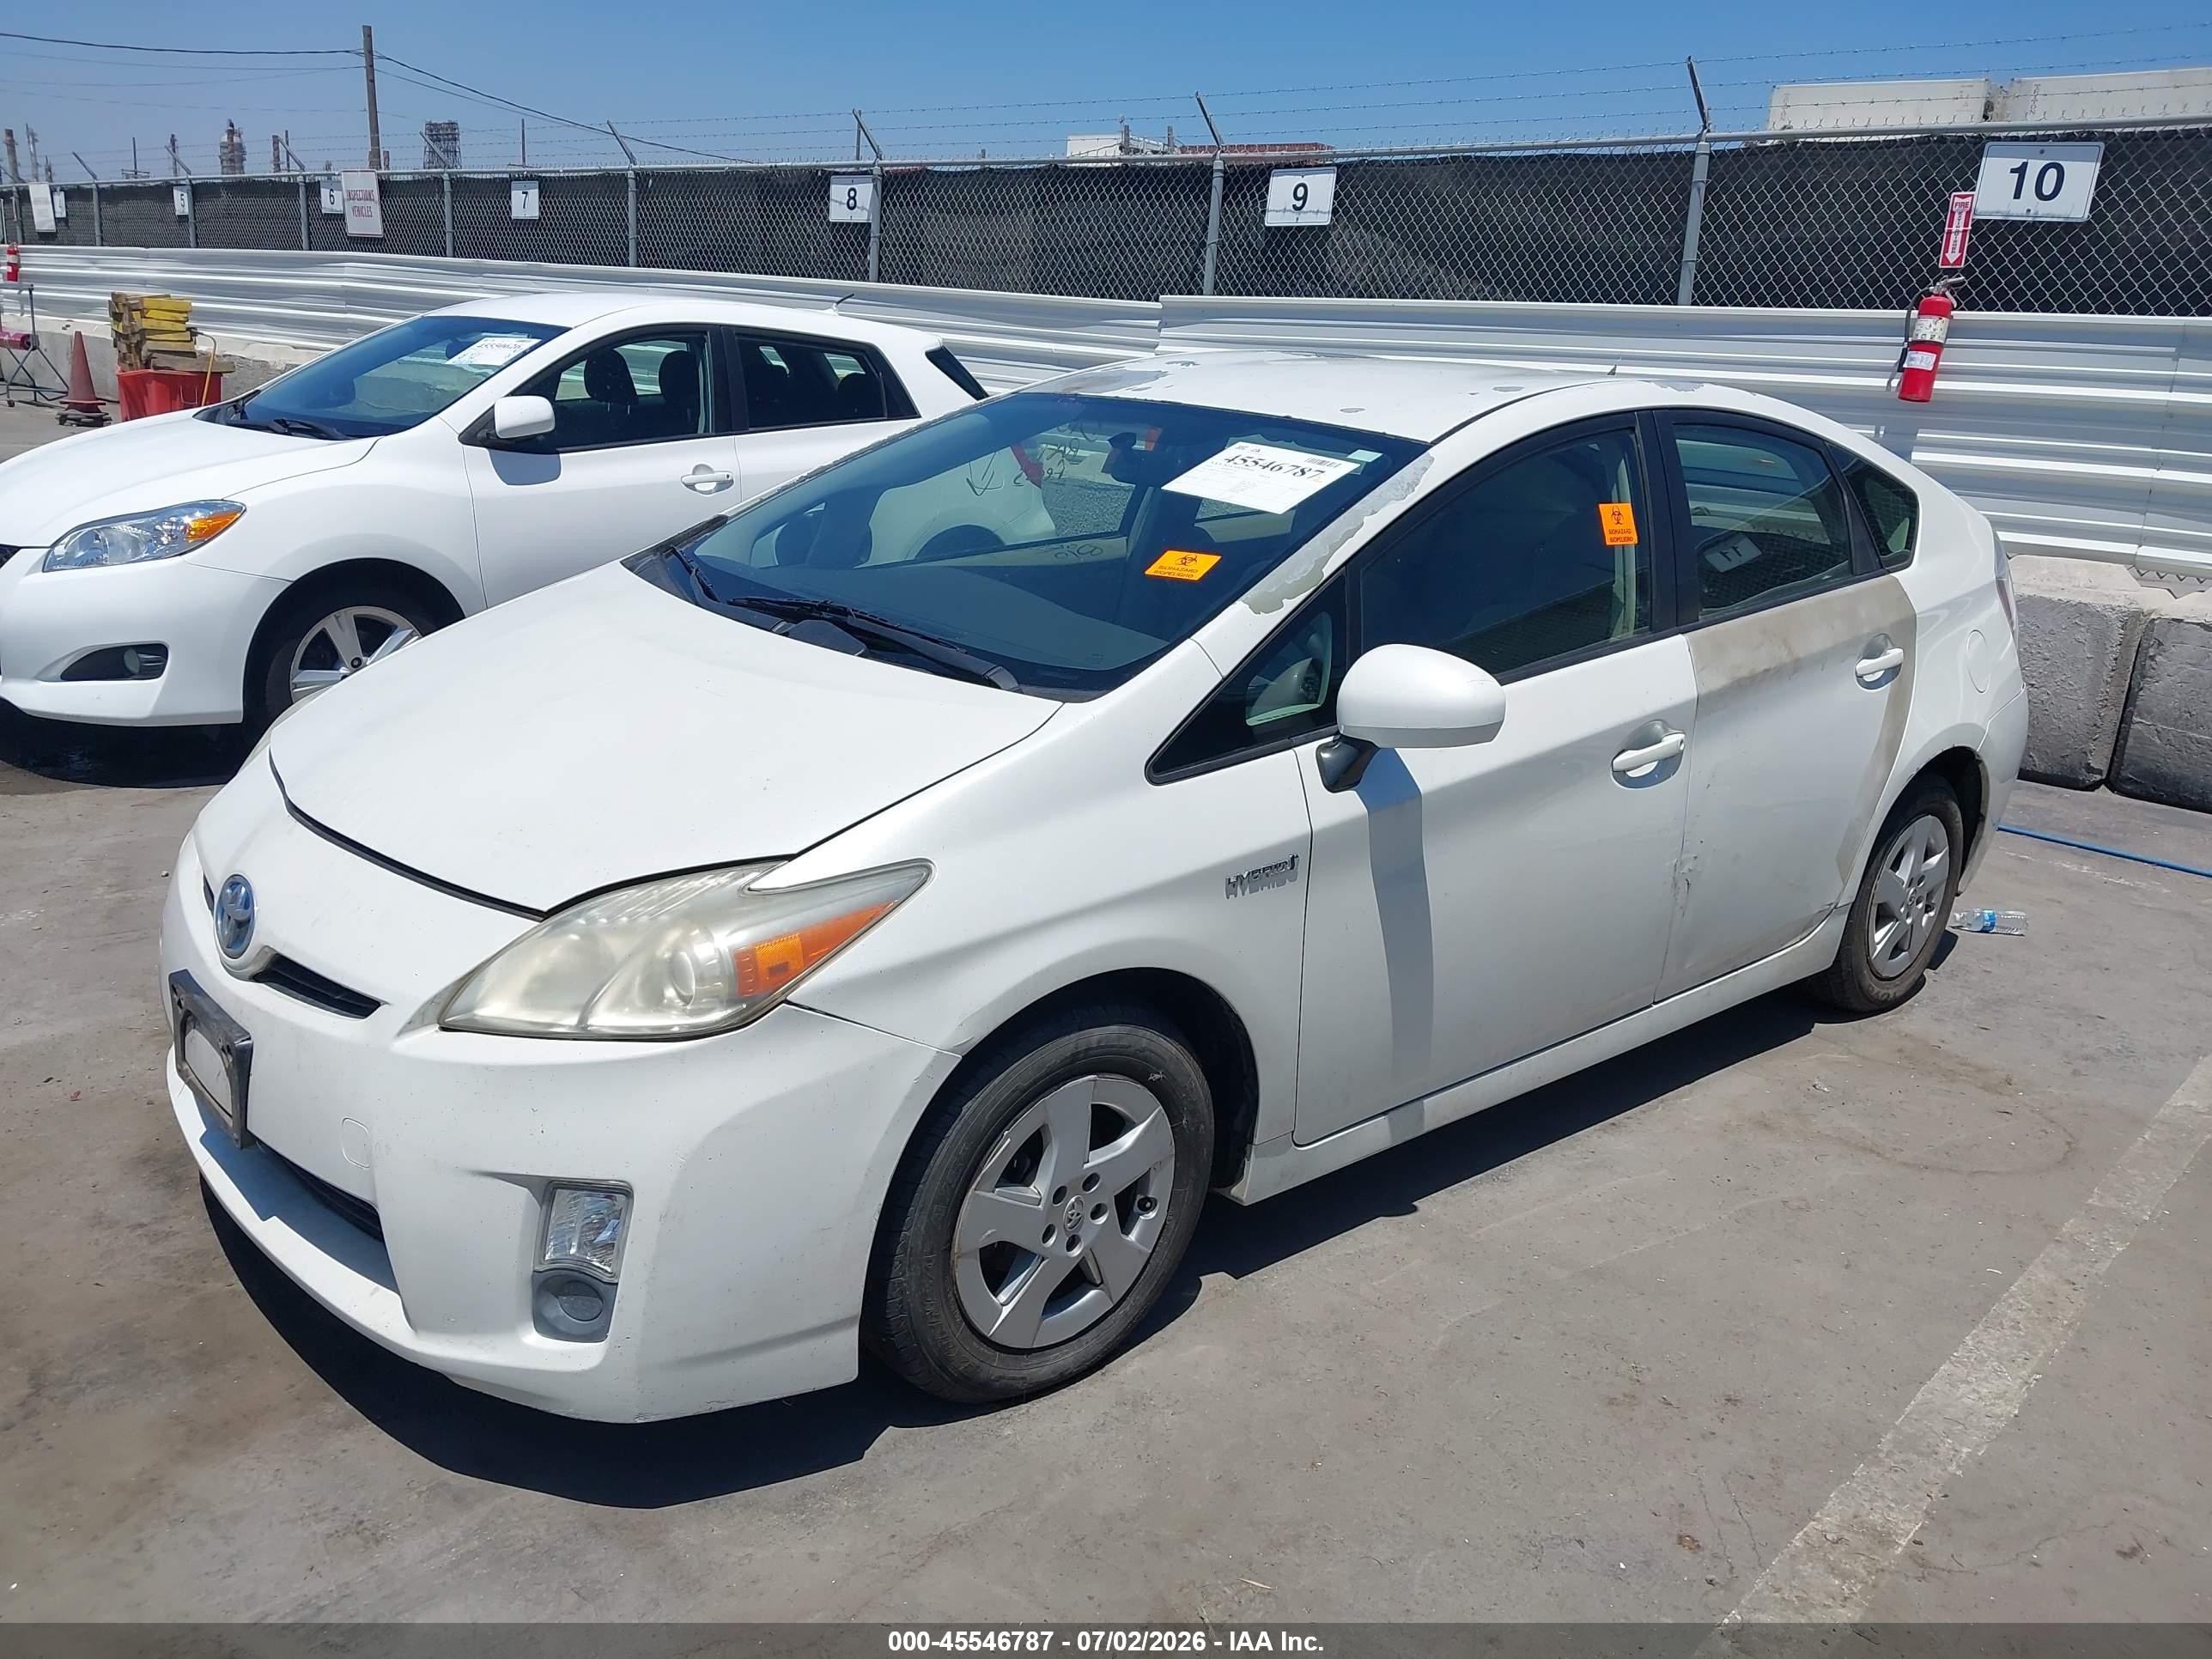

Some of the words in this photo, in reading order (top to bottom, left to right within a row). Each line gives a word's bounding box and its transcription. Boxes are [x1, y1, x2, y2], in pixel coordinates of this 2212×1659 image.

[2008, 161, 2066, 202] 10
[180, 193, 185, 208] 5
[329, 188, 335, 205] 6
[520, 191, 529, 210] 7
[846, 186, 858, 211] 8
[1291, 182, 1309, 212] 9
[351, 205, 373, 218] VEHICLES
[1224, 454, 1326, 479] 45546787
[1224, 860, 1288, 885] HYBRID
